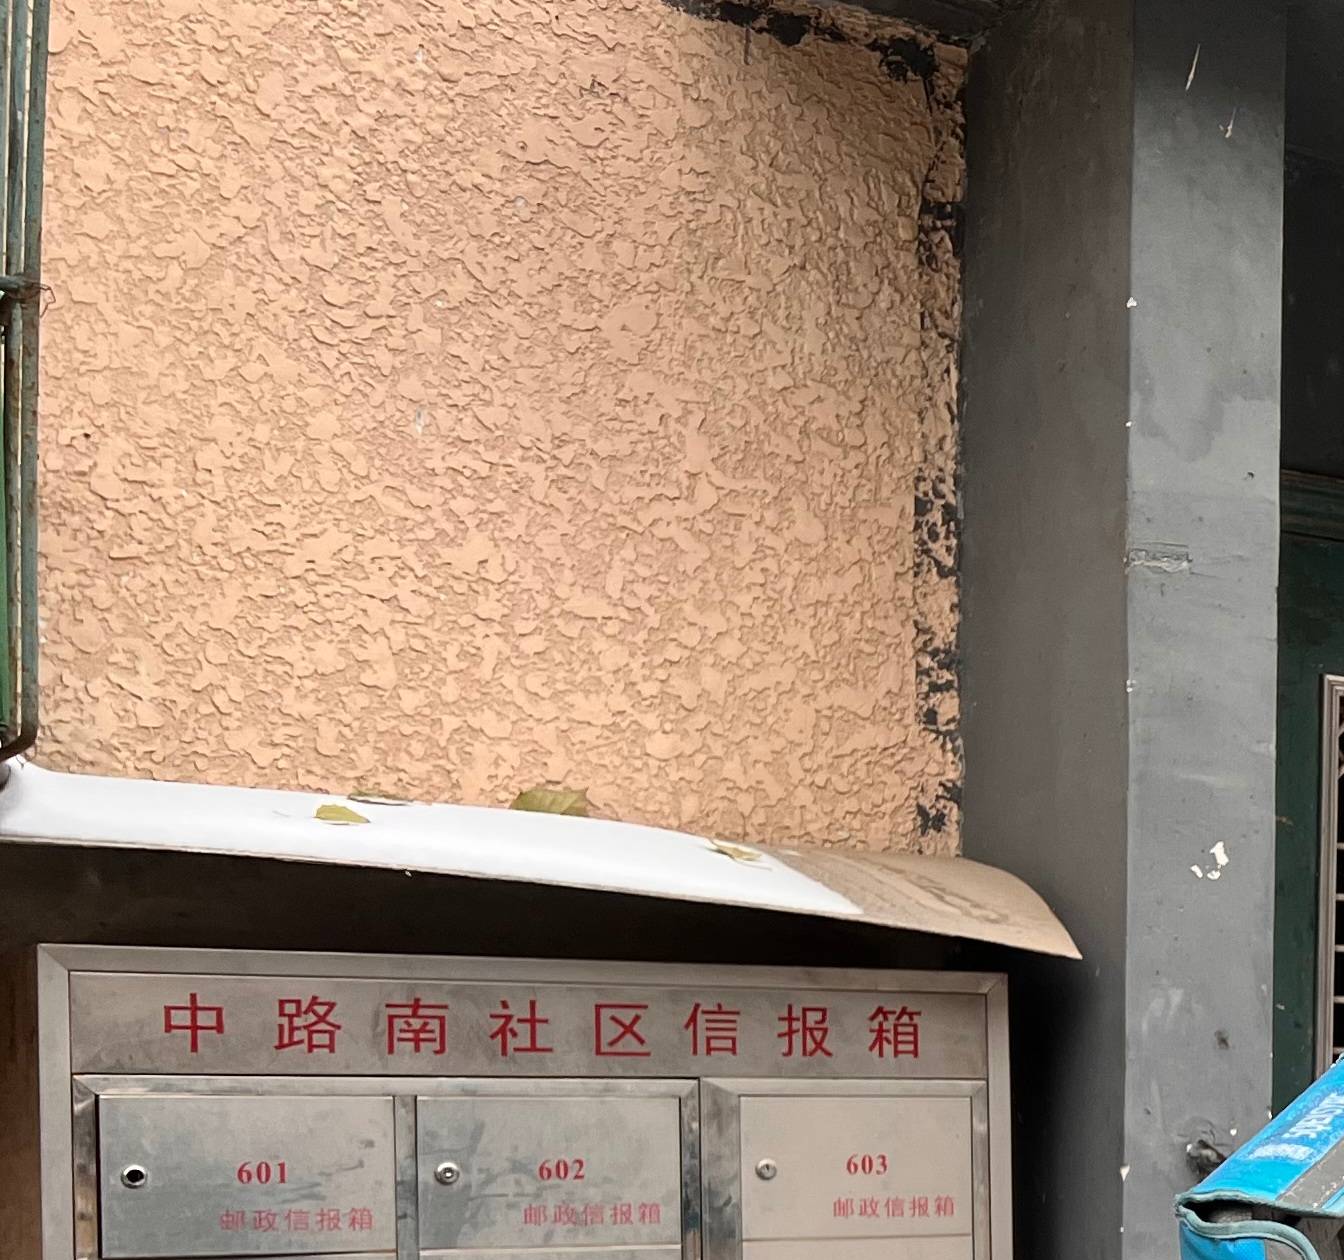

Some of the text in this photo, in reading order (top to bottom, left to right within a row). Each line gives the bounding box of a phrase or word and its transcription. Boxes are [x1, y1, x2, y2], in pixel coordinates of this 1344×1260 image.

[162, 992, 923, 1062] 中路南社区信报箱
[235, 1161, 290, 1187] 601
[537, 1159, 588, 1183] 602
[846, 1155, 891, 1176] 603
[523, 1204, 663, 1227] 邮政信报箱
[834, 1197, 957, 1219] 邮政信报箱
[219, 1208, 377, 1234] 邮政信报箱
